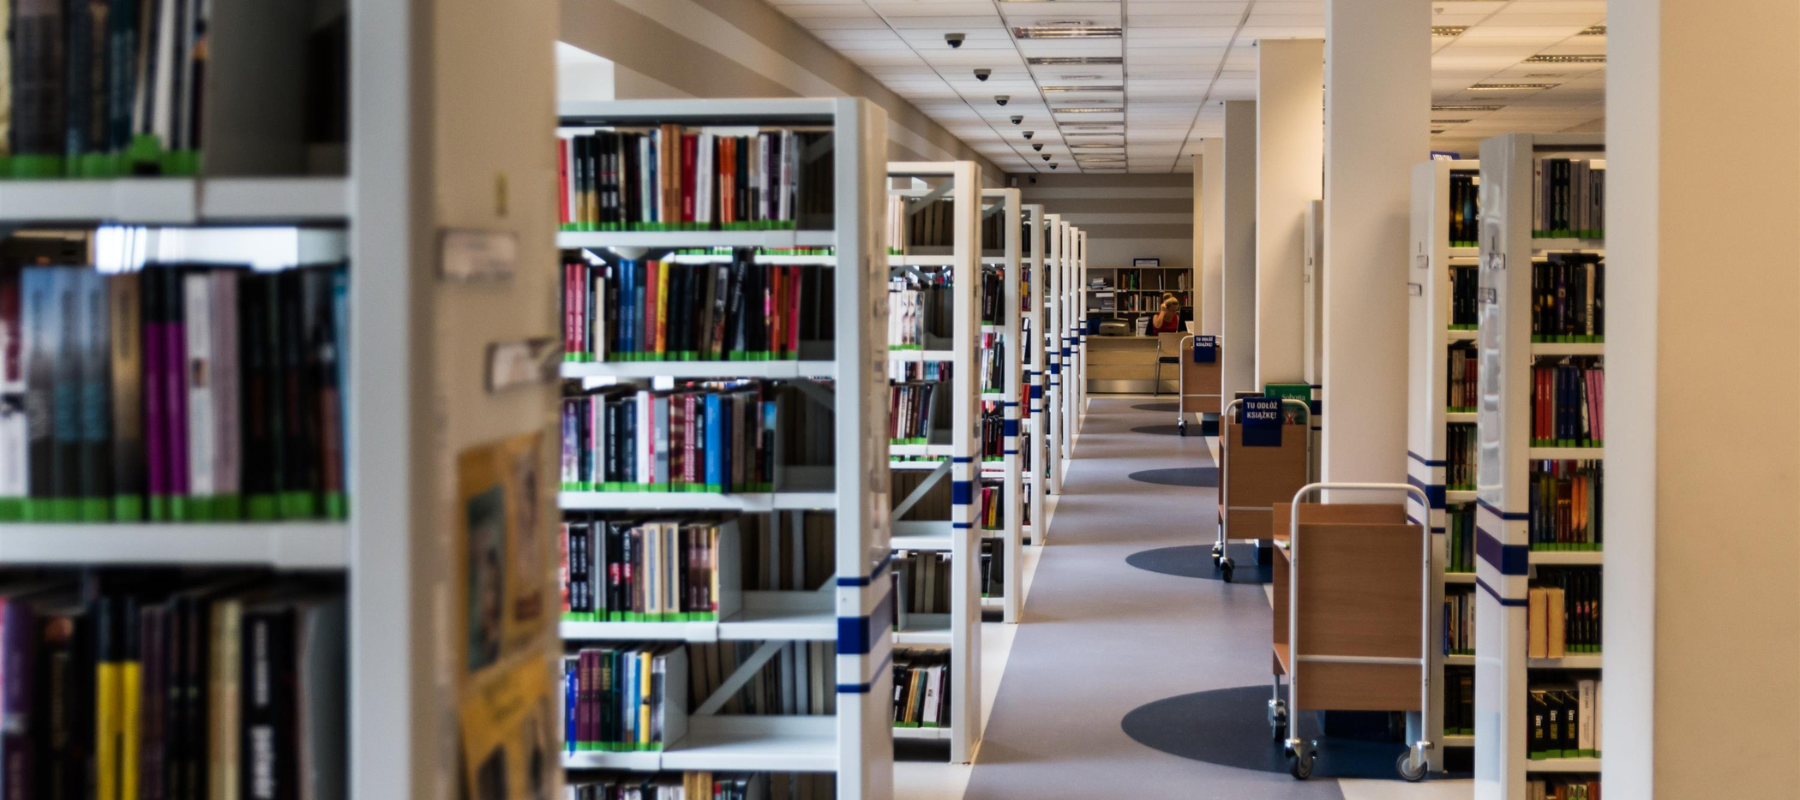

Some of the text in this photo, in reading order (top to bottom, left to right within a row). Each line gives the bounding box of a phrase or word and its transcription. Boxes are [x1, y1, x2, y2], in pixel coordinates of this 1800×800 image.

[1246, 400, 1278, 409] TU ODŁÓŻ
[1246, 410, 1277, 420] KSIĄŻKĘ!
